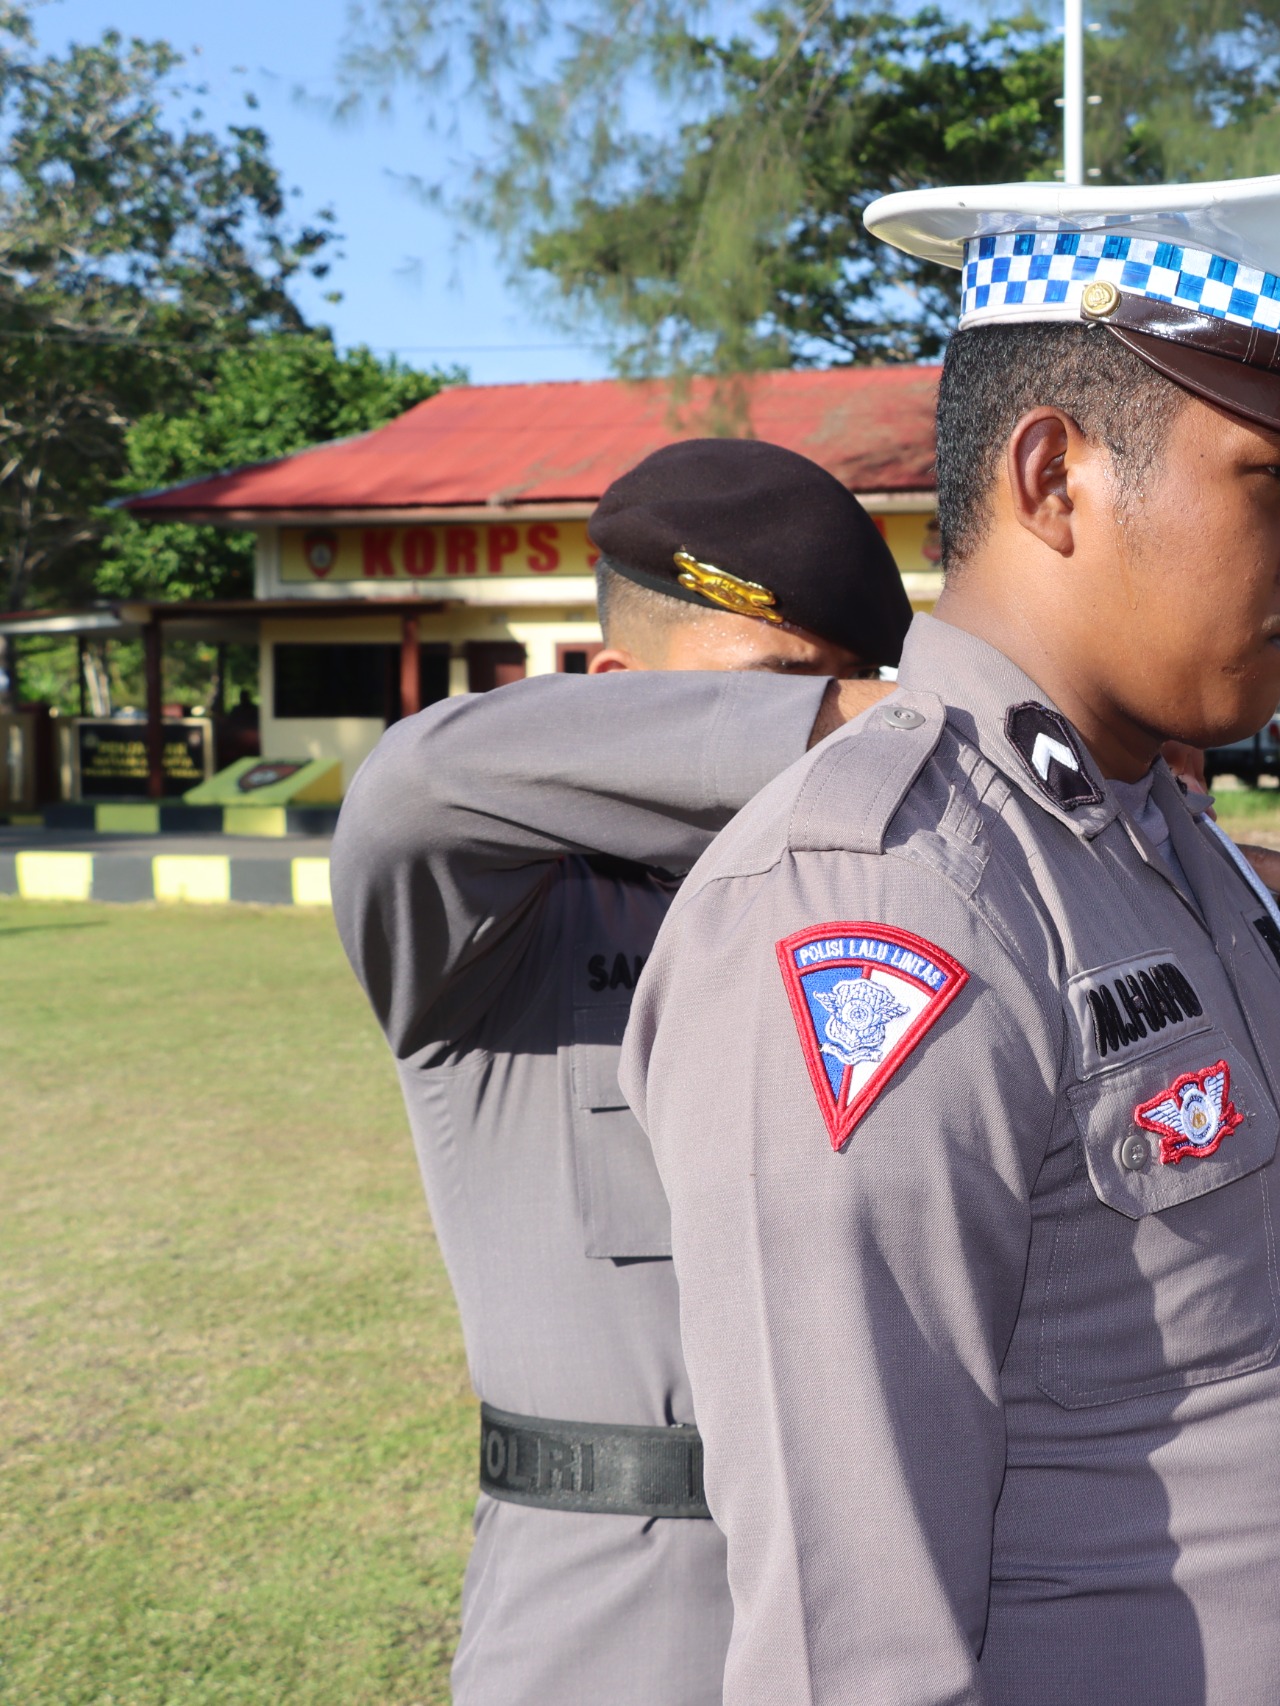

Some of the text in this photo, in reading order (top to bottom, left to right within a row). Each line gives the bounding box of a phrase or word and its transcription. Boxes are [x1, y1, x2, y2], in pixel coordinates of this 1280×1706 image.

[361, 522, 560, 577] KORPS
[800, 939, 942, 987] POLISI LALU LINTAS
[484, 1429, 594, 1492] OLRI
